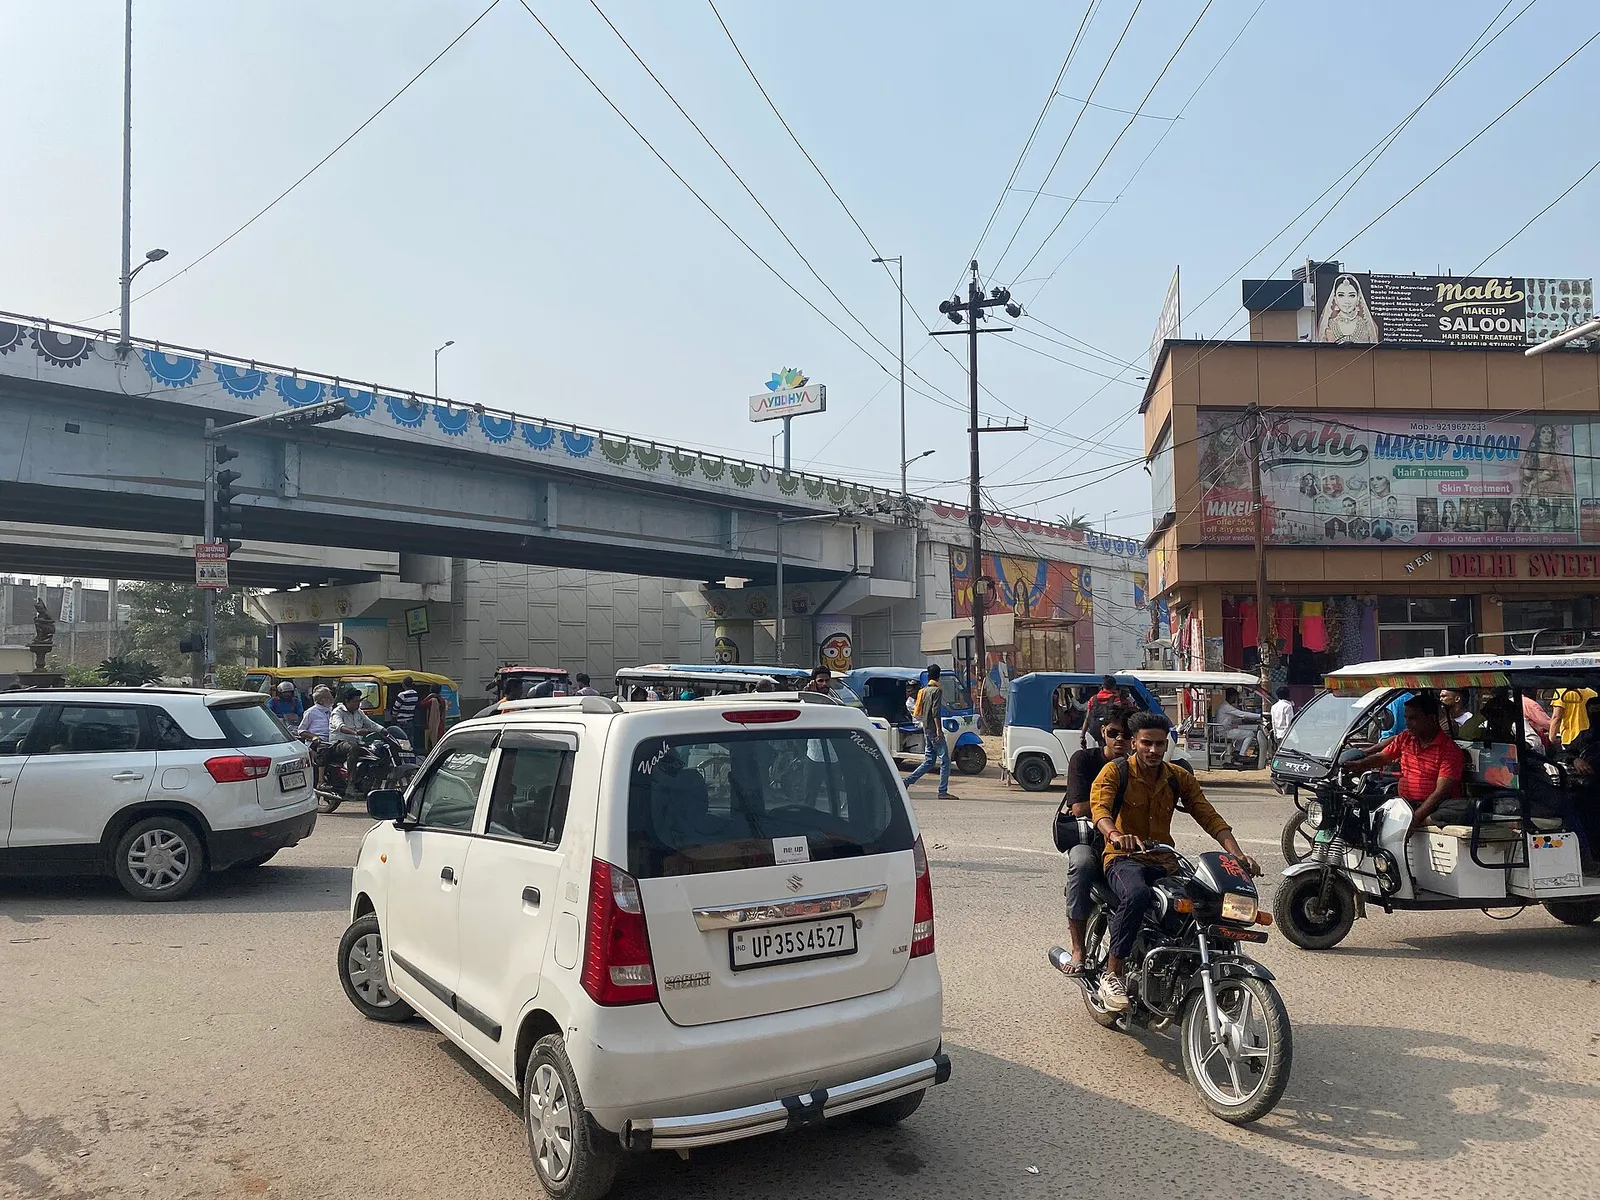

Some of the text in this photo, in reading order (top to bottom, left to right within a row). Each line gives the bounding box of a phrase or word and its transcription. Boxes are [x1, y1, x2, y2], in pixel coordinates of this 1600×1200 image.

[1463, 307, 1506, 315] MAKEUP
[1438, 316, 1526, 333] SALOON
[1436, 423, 1487, 431] 9219627233
[1374, 433, 1521, 462] MAKEUP SALOON
[1397, 468, 1465, 477] Hair Treatment
[1441, 484, 1510, 493] Skin Treatment
[1206, 501, 1254, 517] MAKEU
[1405, 551, 1434, 574] NEW
[1449, 553, 1518, 578] DELHI
[736, 944, 746, 952] IND
[752, 924, 846, 959] UP35S4527
[664, 970, 711, 984] MARUTI
[664, 977, 711, 991] SUZUKI
